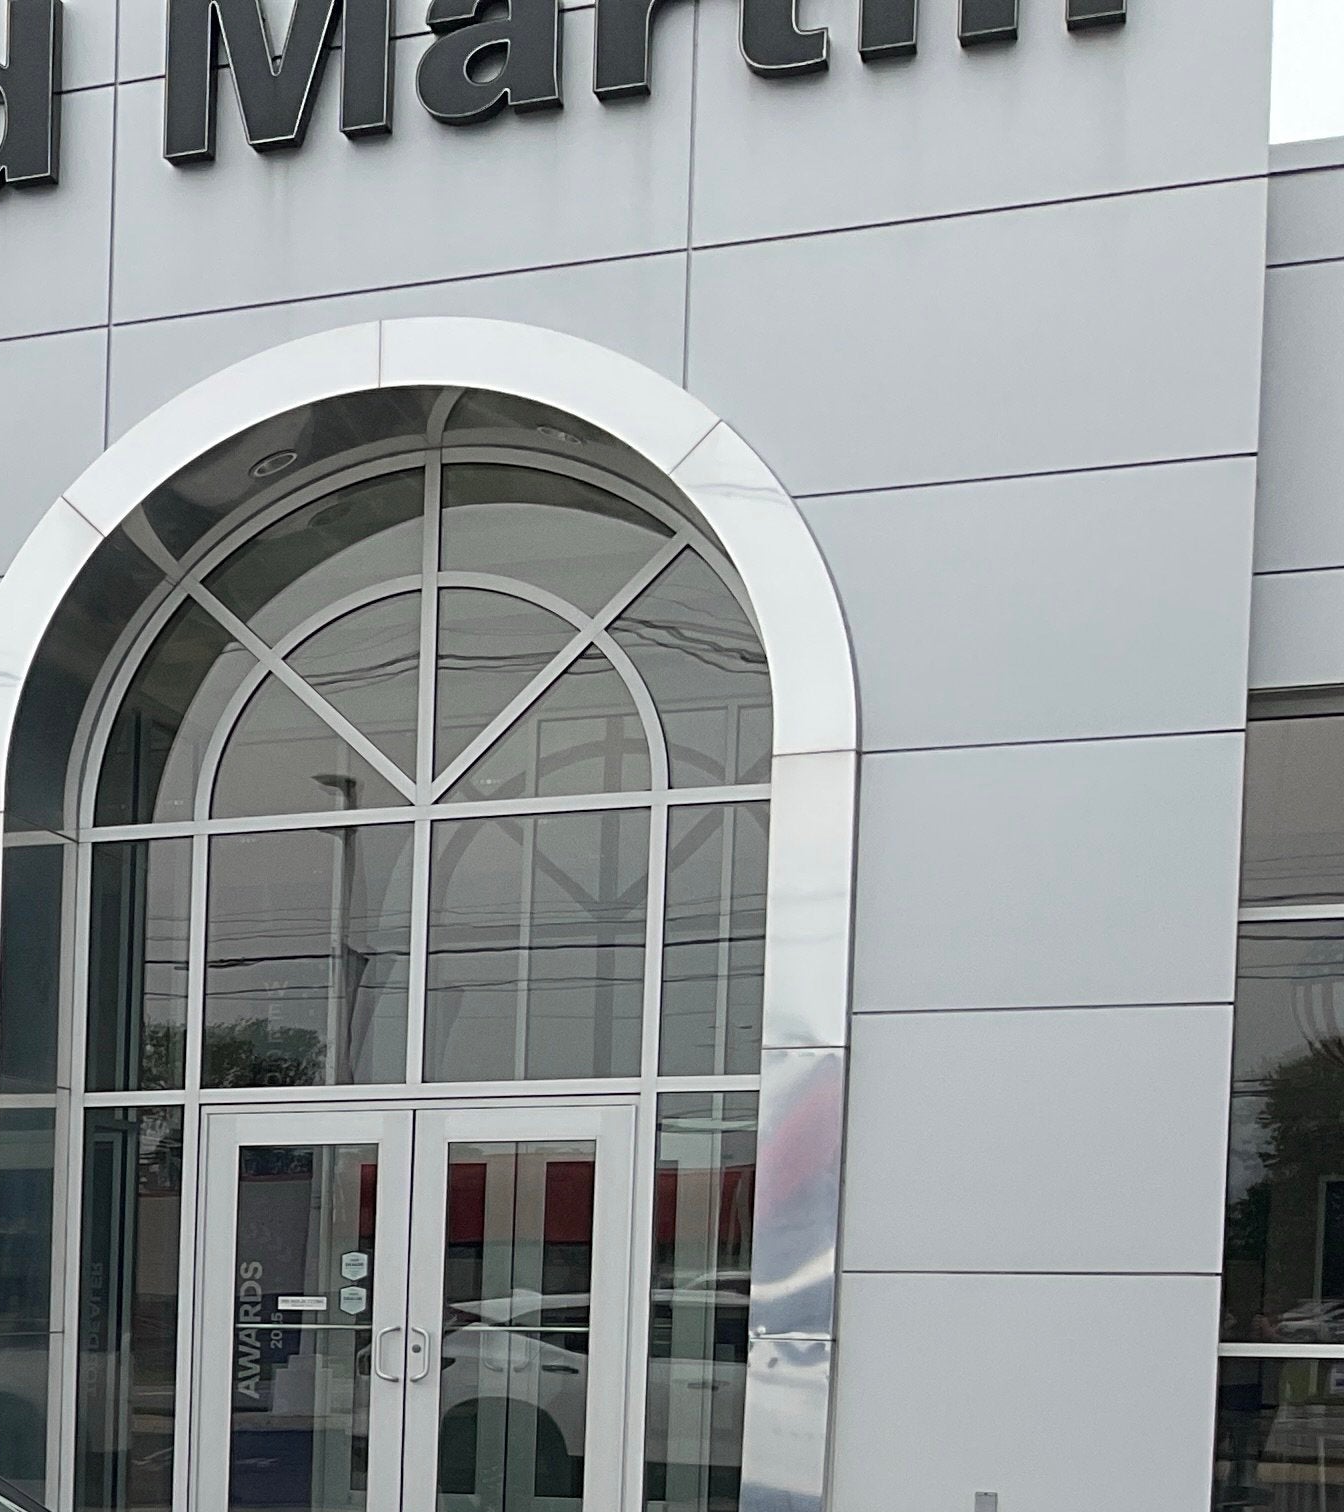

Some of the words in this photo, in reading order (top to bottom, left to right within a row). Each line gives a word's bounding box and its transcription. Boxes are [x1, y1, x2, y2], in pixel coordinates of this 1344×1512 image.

[164, 0, 1127, 166] Mar
[237, 1261, 264, 1399] AWARDS
[270, 1312, 284, 1349] 205
